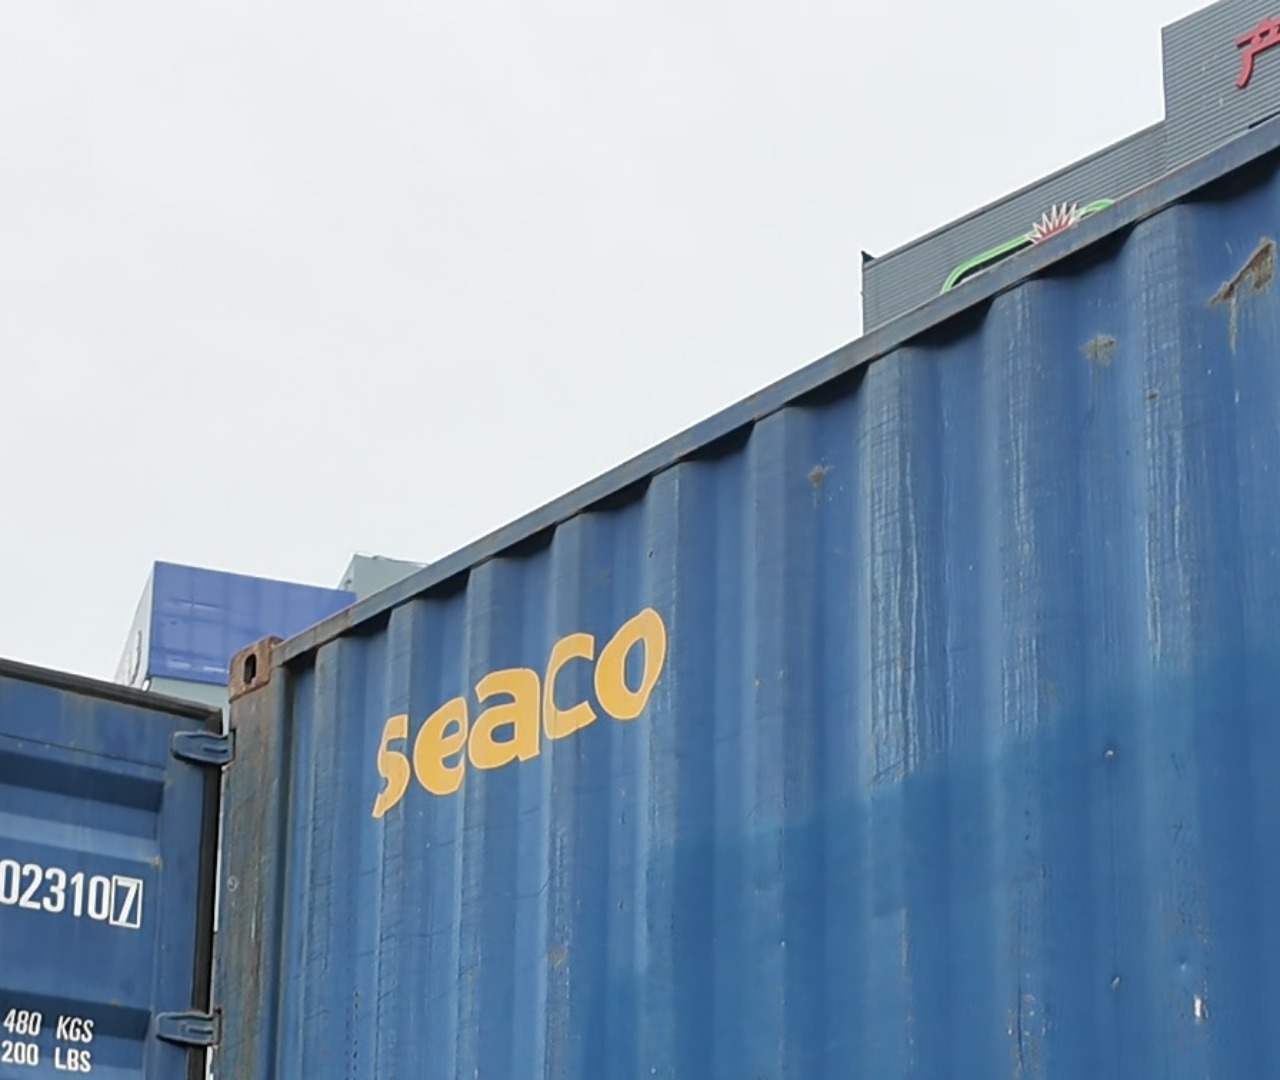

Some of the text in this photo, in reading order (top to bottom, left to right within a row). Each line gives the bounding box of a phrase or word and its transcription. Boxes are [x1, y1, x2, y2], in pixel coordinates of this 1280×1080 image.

[371, 607, 667, 818] seaco
[3, 1009, 42, 1036] 480
[56, 1015, 94, 1043] KGS
[1, 1040, 39, 1067] 200
[54, 1046, 91, 1073] LBS
